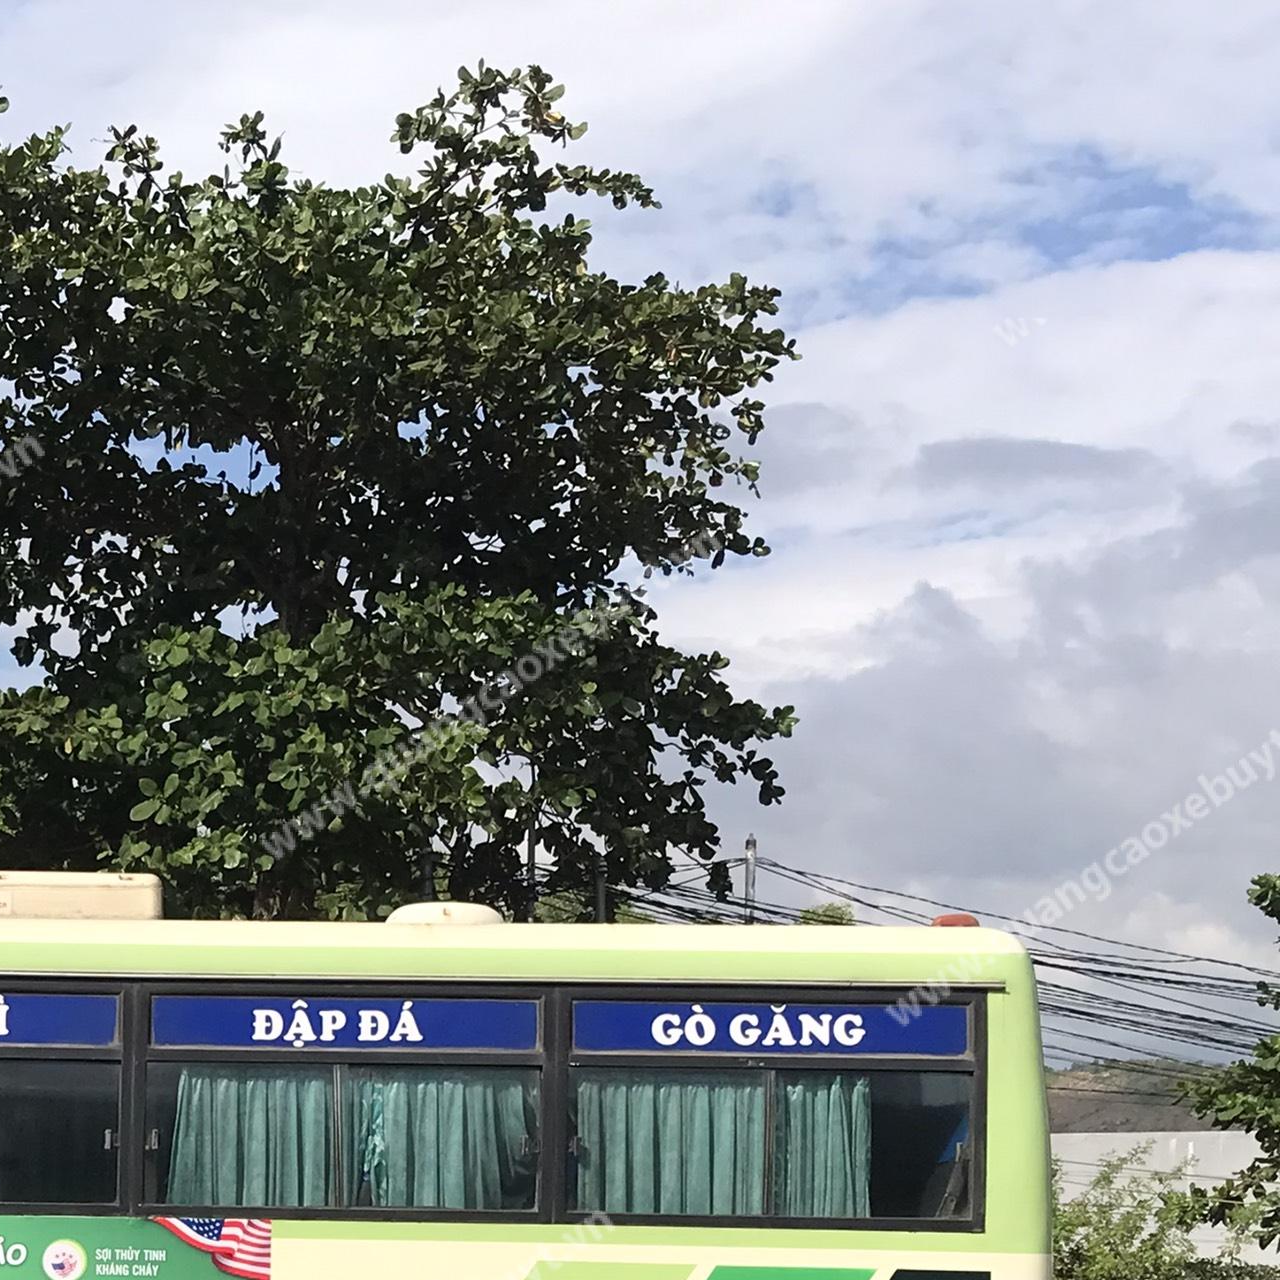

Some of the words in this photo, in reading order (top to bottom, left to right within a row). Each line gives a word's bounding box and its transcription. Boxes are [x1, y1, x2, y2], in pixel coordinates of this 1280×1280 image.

[252, 999, 347, 1048] ĐẬP
[357, 1000, 423, 1042] ĐÁ
[651, 1004, 716, 1046] GÒ
[729, 1004, 866, 1046] GĂNG
[114, 1246, 141, 1262] THỦY
[143, 1249, 167, 1262] TINH
[95, 1262, 129, 1276] KHÁNG
[132, 1263, 159, 1277] CHÁY
